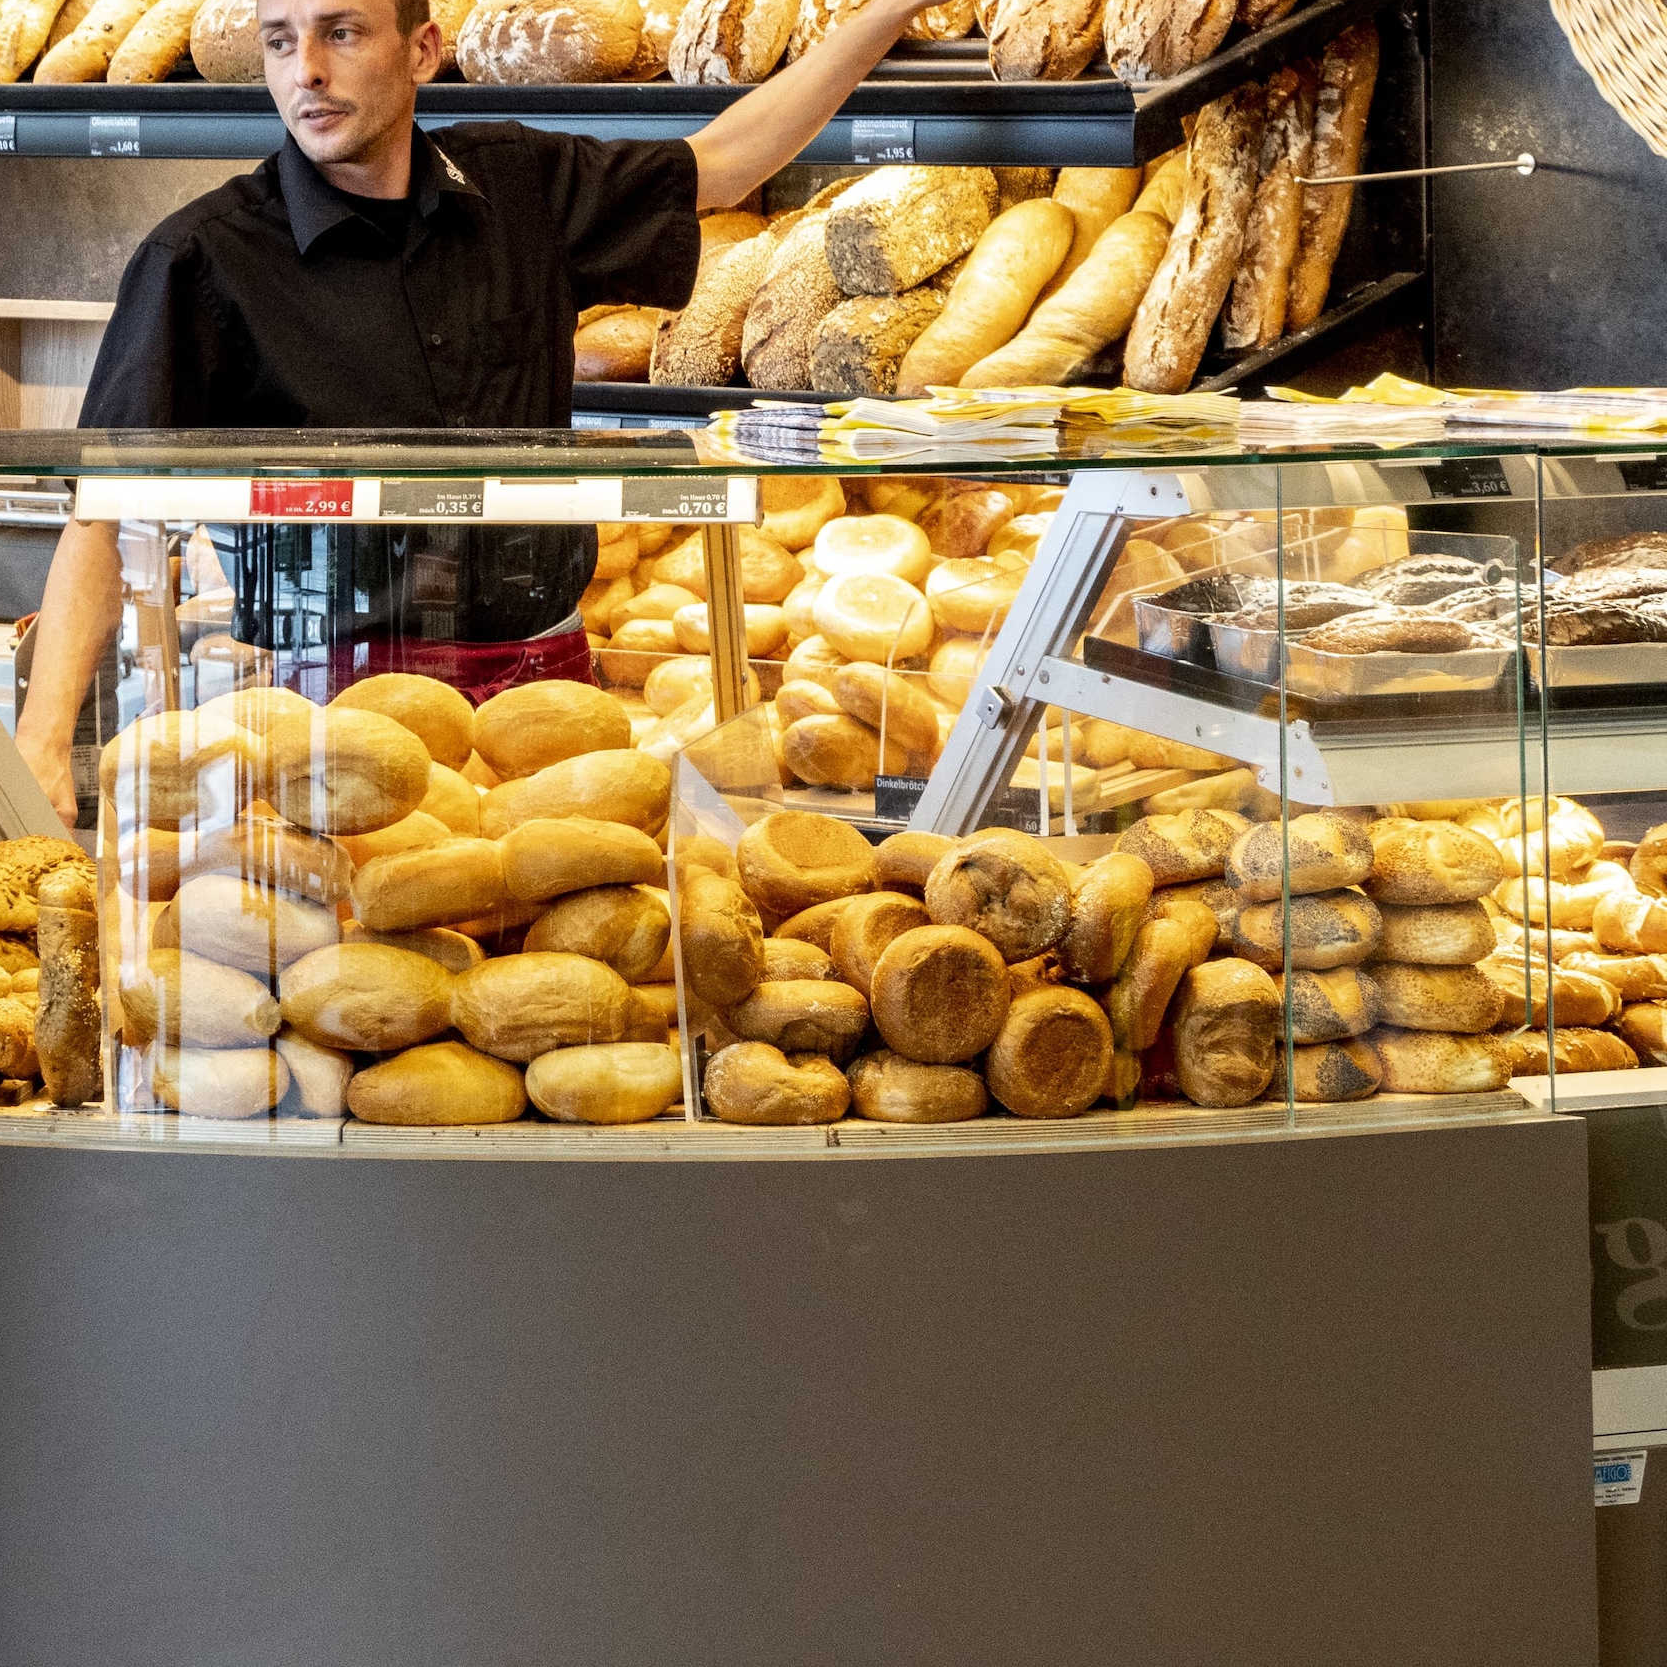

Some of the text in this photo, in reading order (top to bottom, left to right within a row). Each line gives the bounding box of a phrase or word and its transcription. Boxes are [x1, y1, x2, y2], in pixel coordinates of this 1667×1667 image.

[886, 147, 905, 159] 1,95
[1473, 481, 1498, 494] 3,60
[305, 500, 337, 514] 2,99
[341, 501, 351, 512] €
[436, 501, 468, 515] 0,35
[471, 501, 482, 513] €
[679, 502, 711, 516] 0,70
[715, 502, 726, 514] €
